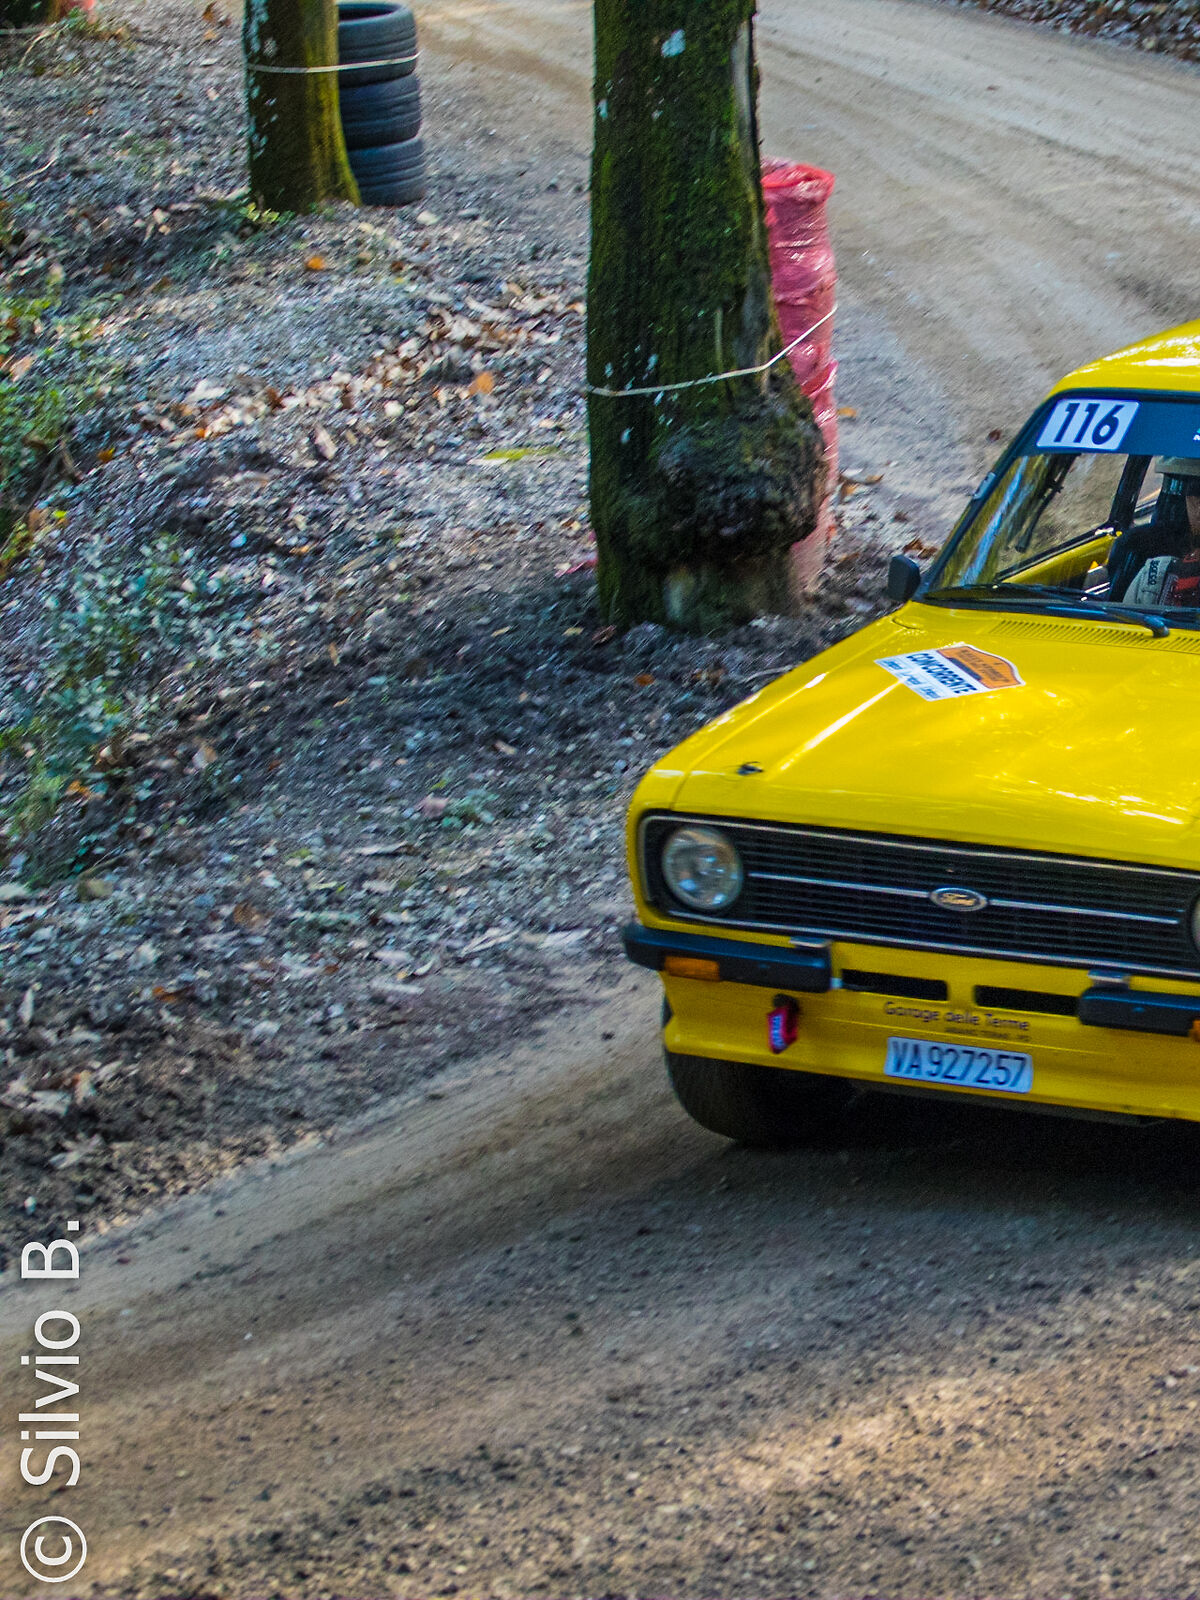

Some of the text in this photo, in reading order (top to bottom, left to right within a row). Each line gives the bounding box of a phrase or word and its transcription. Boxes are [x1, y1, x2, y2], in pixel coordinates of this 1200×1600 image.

[1053, 403, 1125, 445] 116
[884, 1001, 1030, 1031] Garage delle Terme
